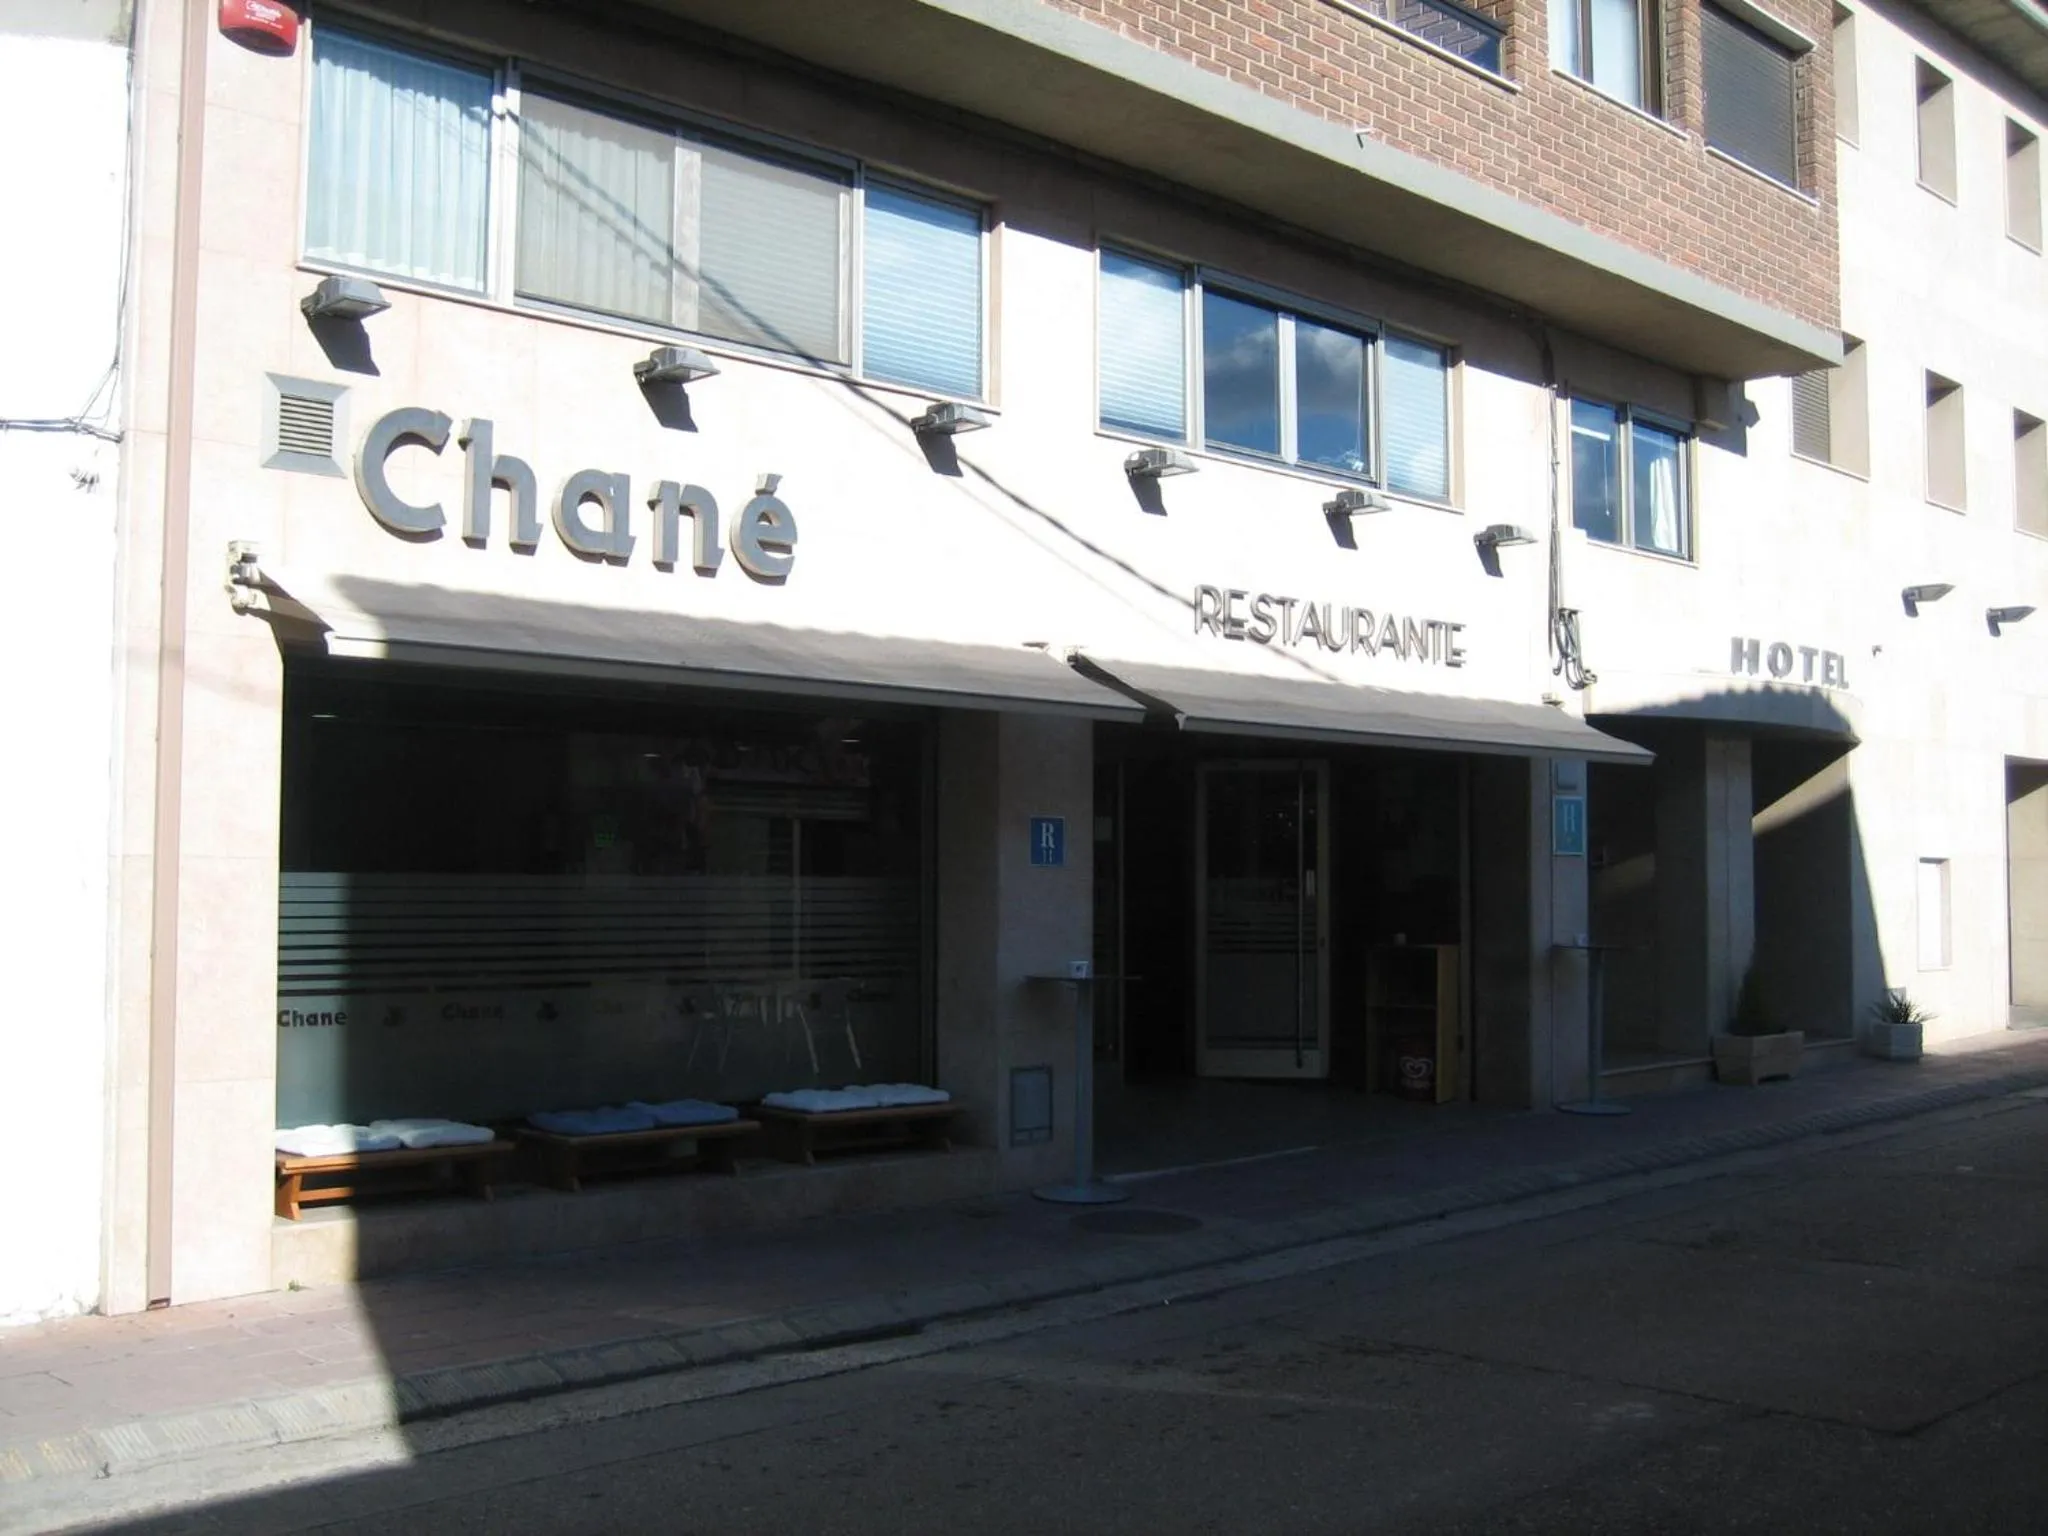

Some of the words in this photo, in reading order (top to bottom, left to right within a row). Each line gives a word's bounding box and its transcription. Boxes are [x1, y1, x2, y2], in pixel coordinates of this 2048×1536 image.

[354, 407, 798, 584] Chané
[1194, 584, 1467, 668] RESTAURANTE
[1730, 636, 1850, 690] HOTEL
[1040, 821, 1056, 849] R
